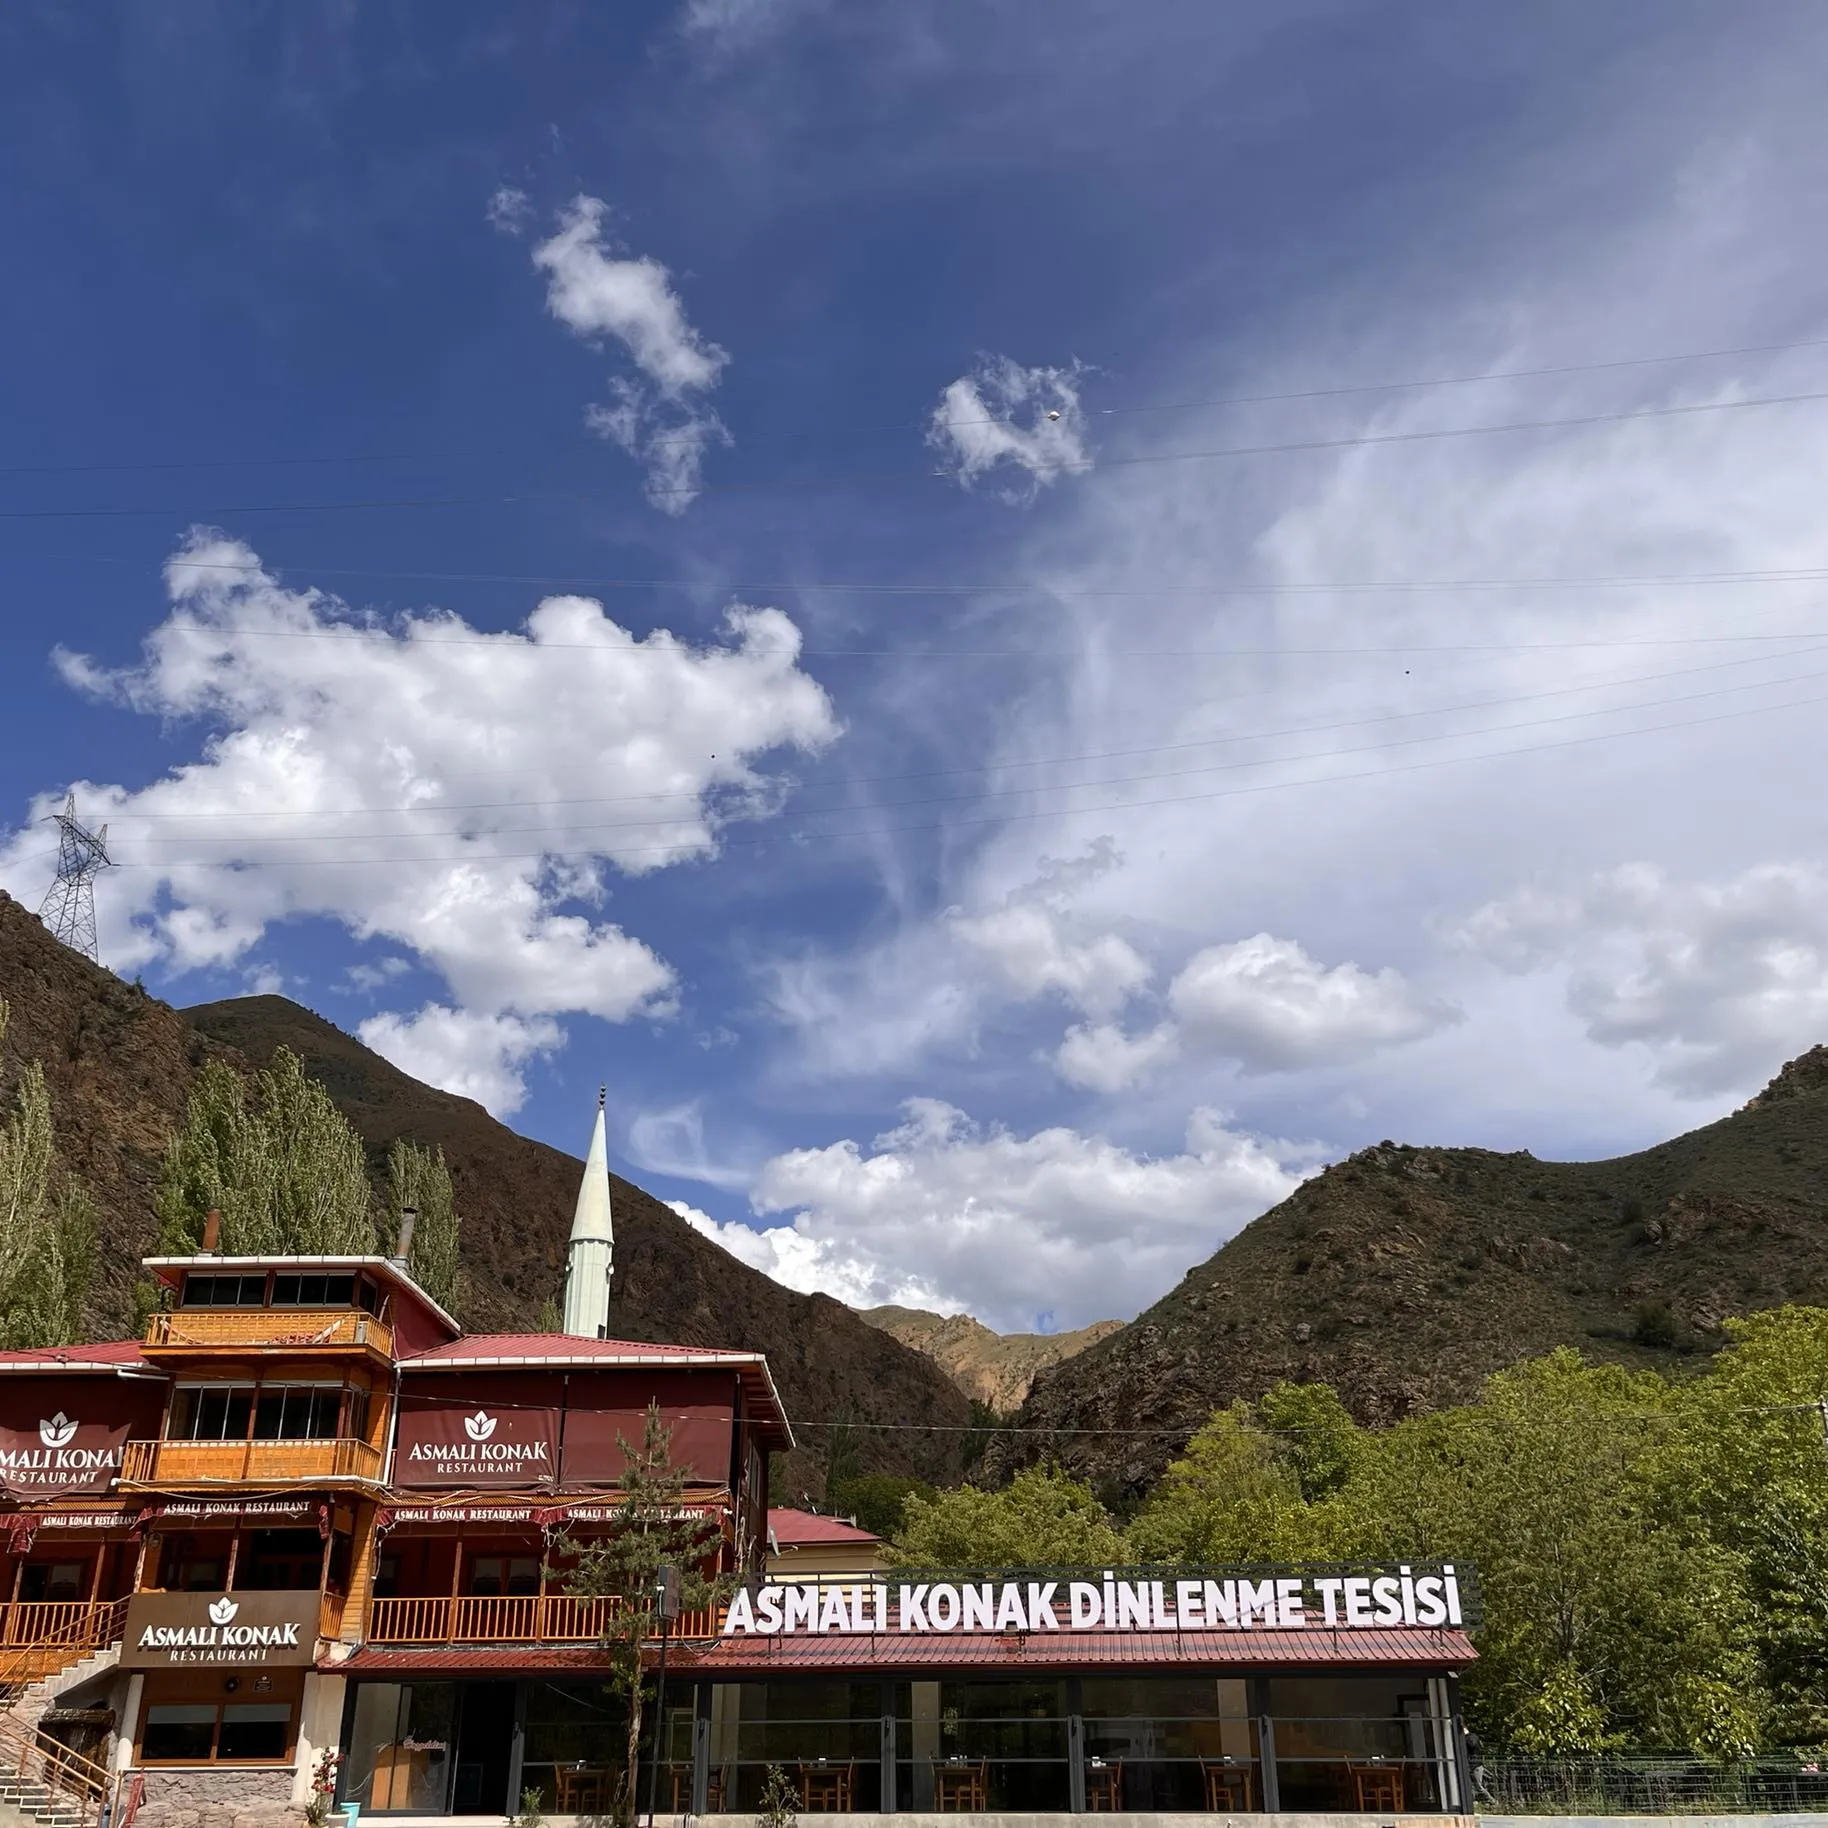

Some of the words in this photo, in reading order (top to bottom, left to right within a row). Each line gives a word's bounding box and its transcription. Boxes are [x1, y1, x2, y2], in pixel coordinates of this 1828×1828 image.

[408, 1442, 475, 1460] ASMALI
[480, 1441, 548, 1460] KONAK
[437, 1462, 523, 1473] RESTAURANT
[0, 1467, 98, 1484] RESTAURANT
[163, 1503, 201, 1514] ASMALI
[205, 1503, 240, 1513] KONAK
[245, 1501, 310, 1512] RESTAURANT
[567, 1508, 601, 1519] ASMALI
[42, 1516, 67, 1526] ASMALI
[69, 1515, 93, 1526] KONAK
[94, 1515, 137, 1526] RESTAURANT
[394, 1510, 429, 1520] ASMALI
[432, 1510, 466, 1520] KONAK
[469, 1509, 531, 1520] RESTAURANT
[723, 1584, 887, 1633] ASMALI
[900, 1582, 1060, 1631] KONAK
[1069, 1571, 1306, 1628] DİNLENME
[1313, 1565, 1462, 1627] TESİSİ
[137, 1624, 216, 1647] ASMALI
[221, 1622, 301, 1646] KONAK
[169, 1648, 267, 1661] RESTAURANT
